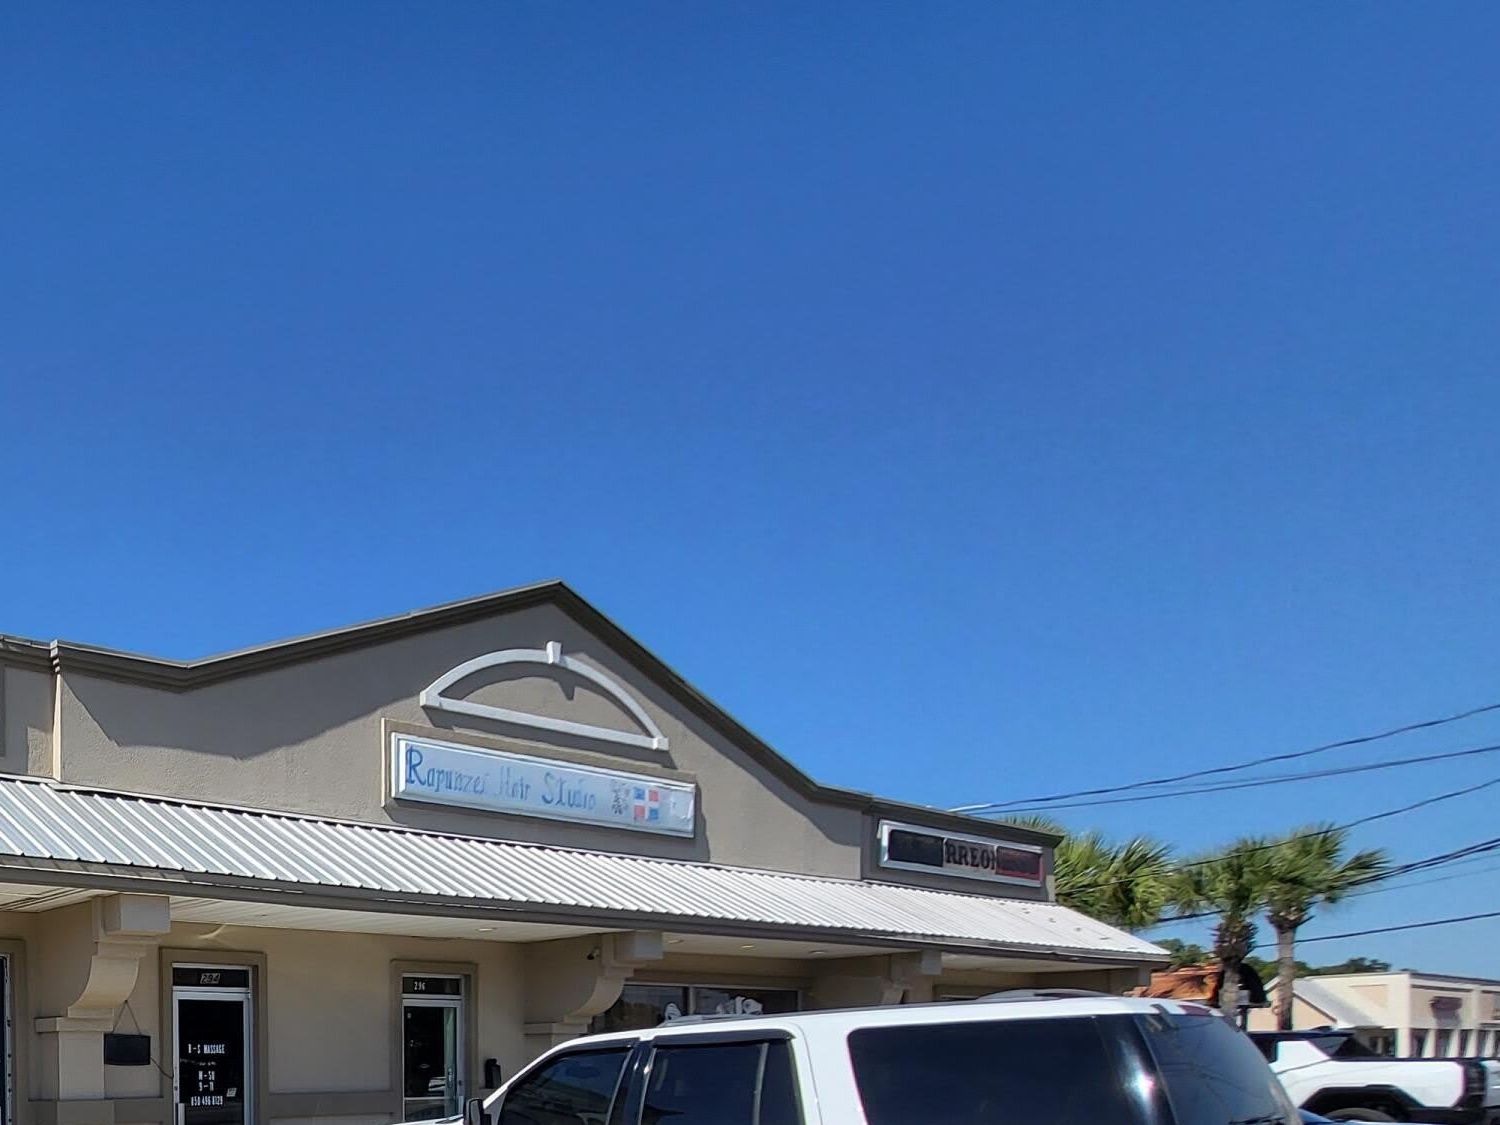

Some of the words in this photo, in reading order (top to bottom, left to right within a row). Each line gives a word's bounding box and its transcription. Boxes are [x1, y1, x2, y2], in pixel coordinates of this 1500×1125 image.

[542, 771, 597, 810] Studio
[414, 981, 426, 991] 296
[203, 1044, 225, 1054] MASSAGE
[191, 1096, 201, 1106] 850
